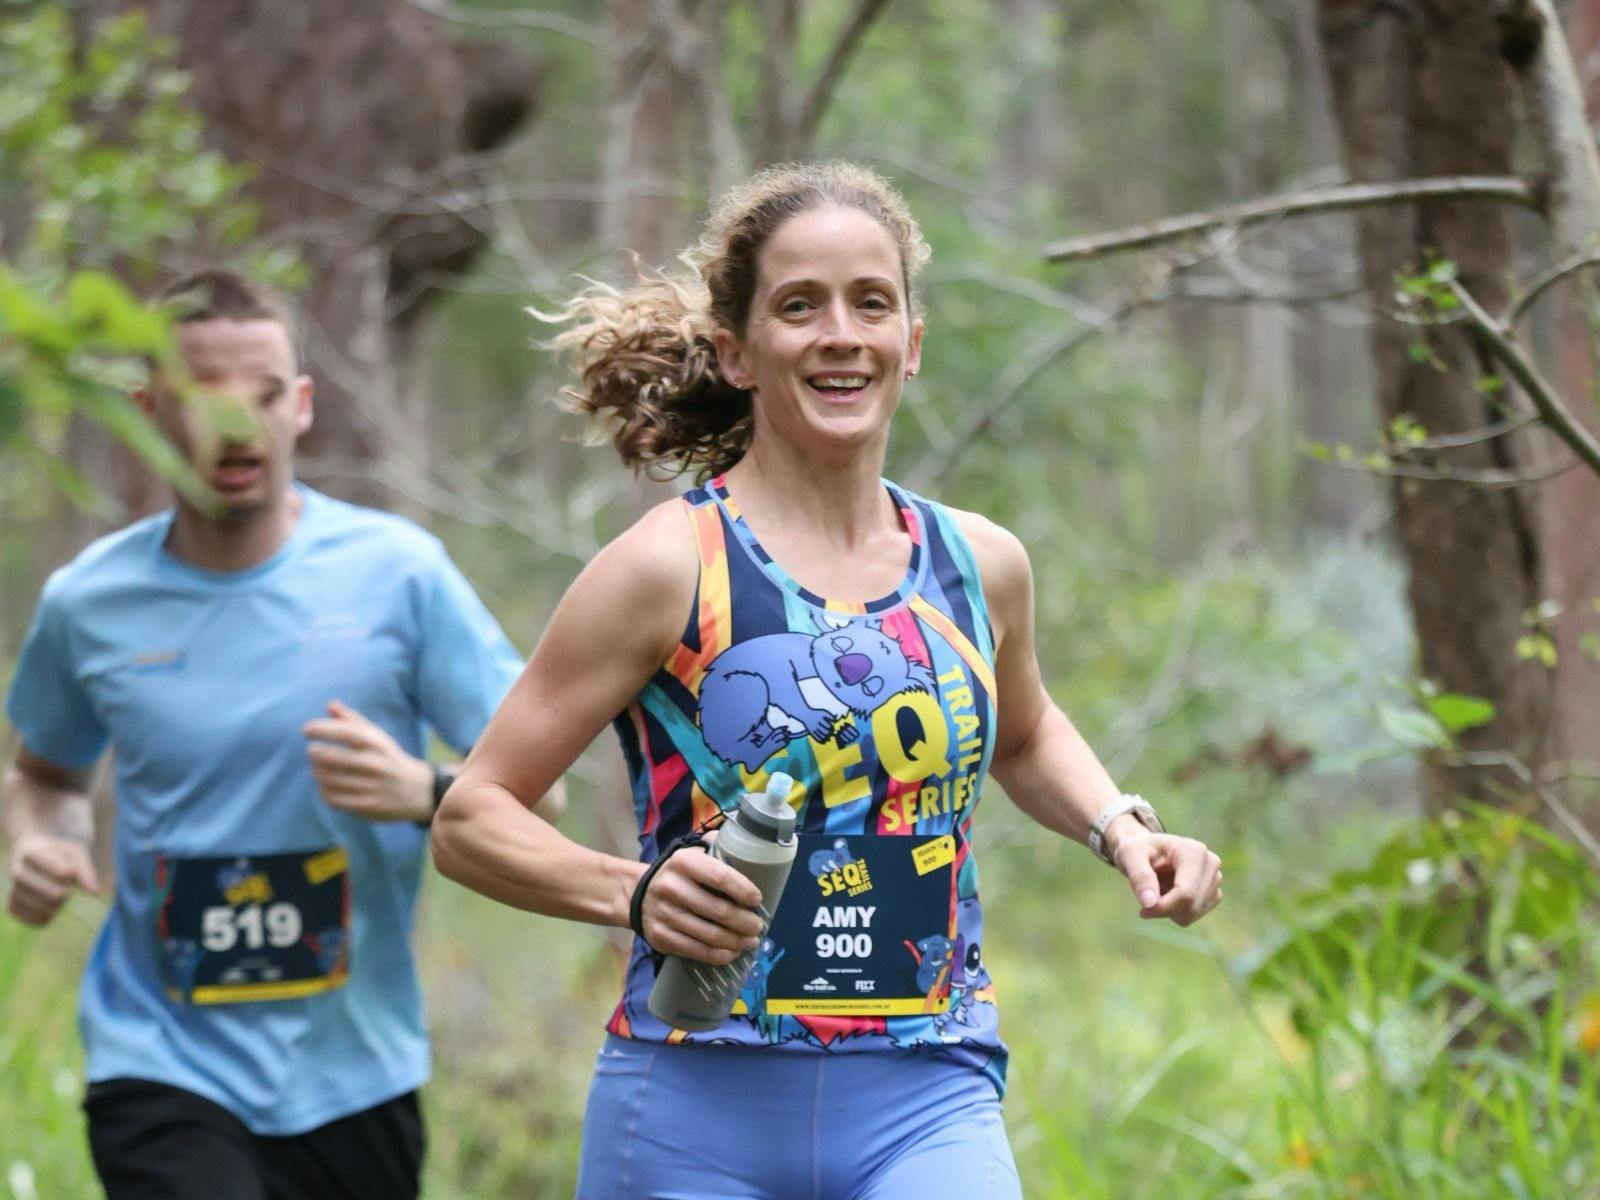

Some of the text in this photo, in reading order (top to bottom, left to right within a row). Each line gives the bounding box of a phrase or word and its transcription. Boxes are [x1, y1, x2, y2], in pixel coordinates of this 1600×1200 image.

[937, 664, 982, 771] TRAIL
[881, 772, 977, 833] SERIES
[817, 863, 862, 897] SEQ
[202, 902, 303, 952] 519
[812, 906, 877, 928] AMY
[815, 933, 873, 959] 900
